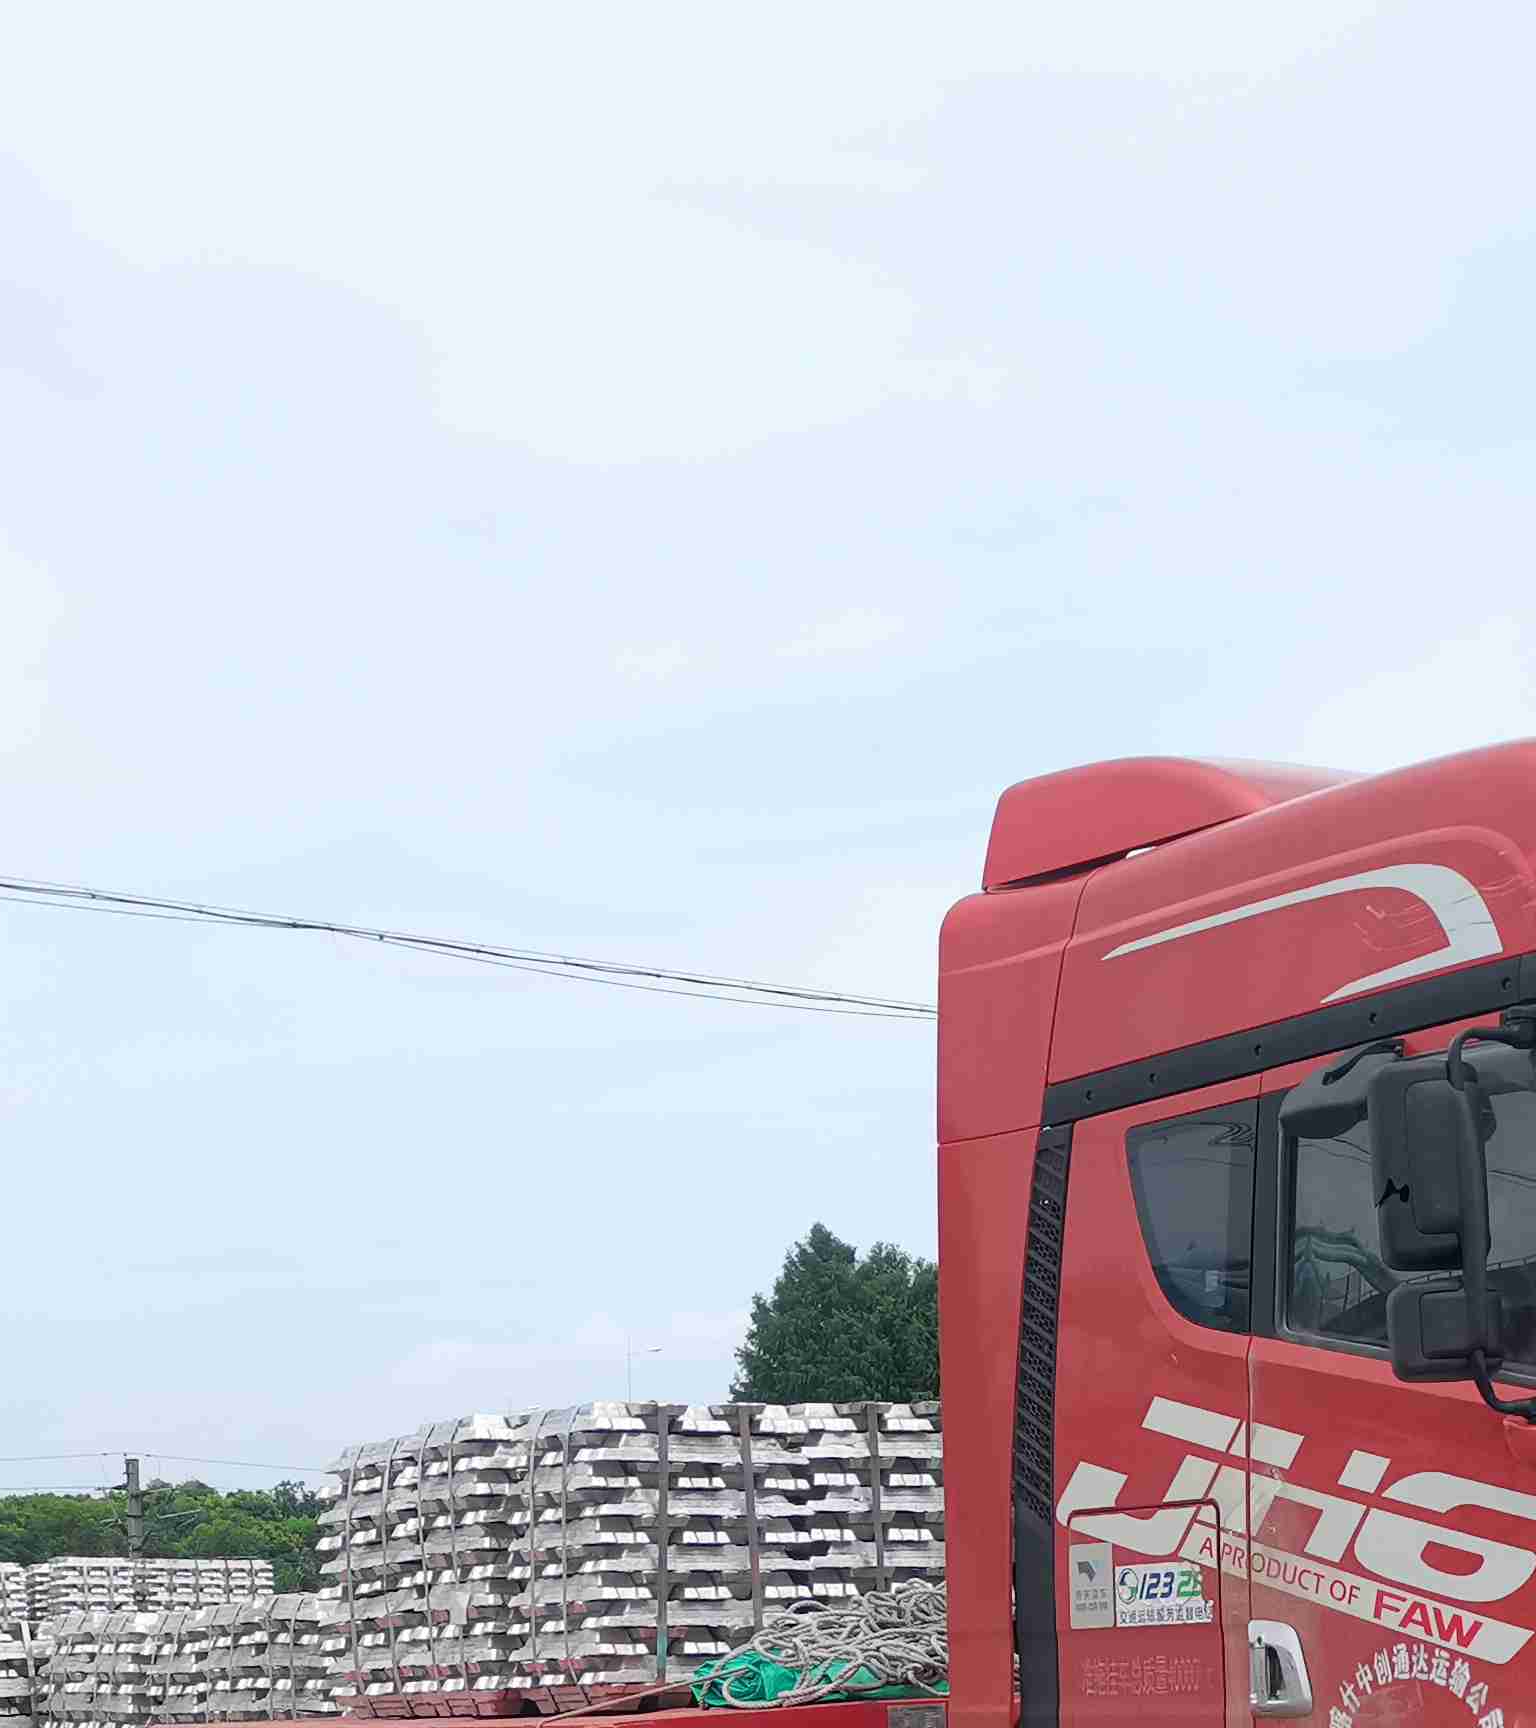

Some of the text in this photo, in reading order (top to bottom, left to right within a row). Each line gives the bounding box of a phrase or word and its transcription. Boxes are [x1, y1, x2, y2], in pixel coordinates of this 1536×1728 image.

[1199, 1536, 1485, 1650] A PRODUCT OF FAW
